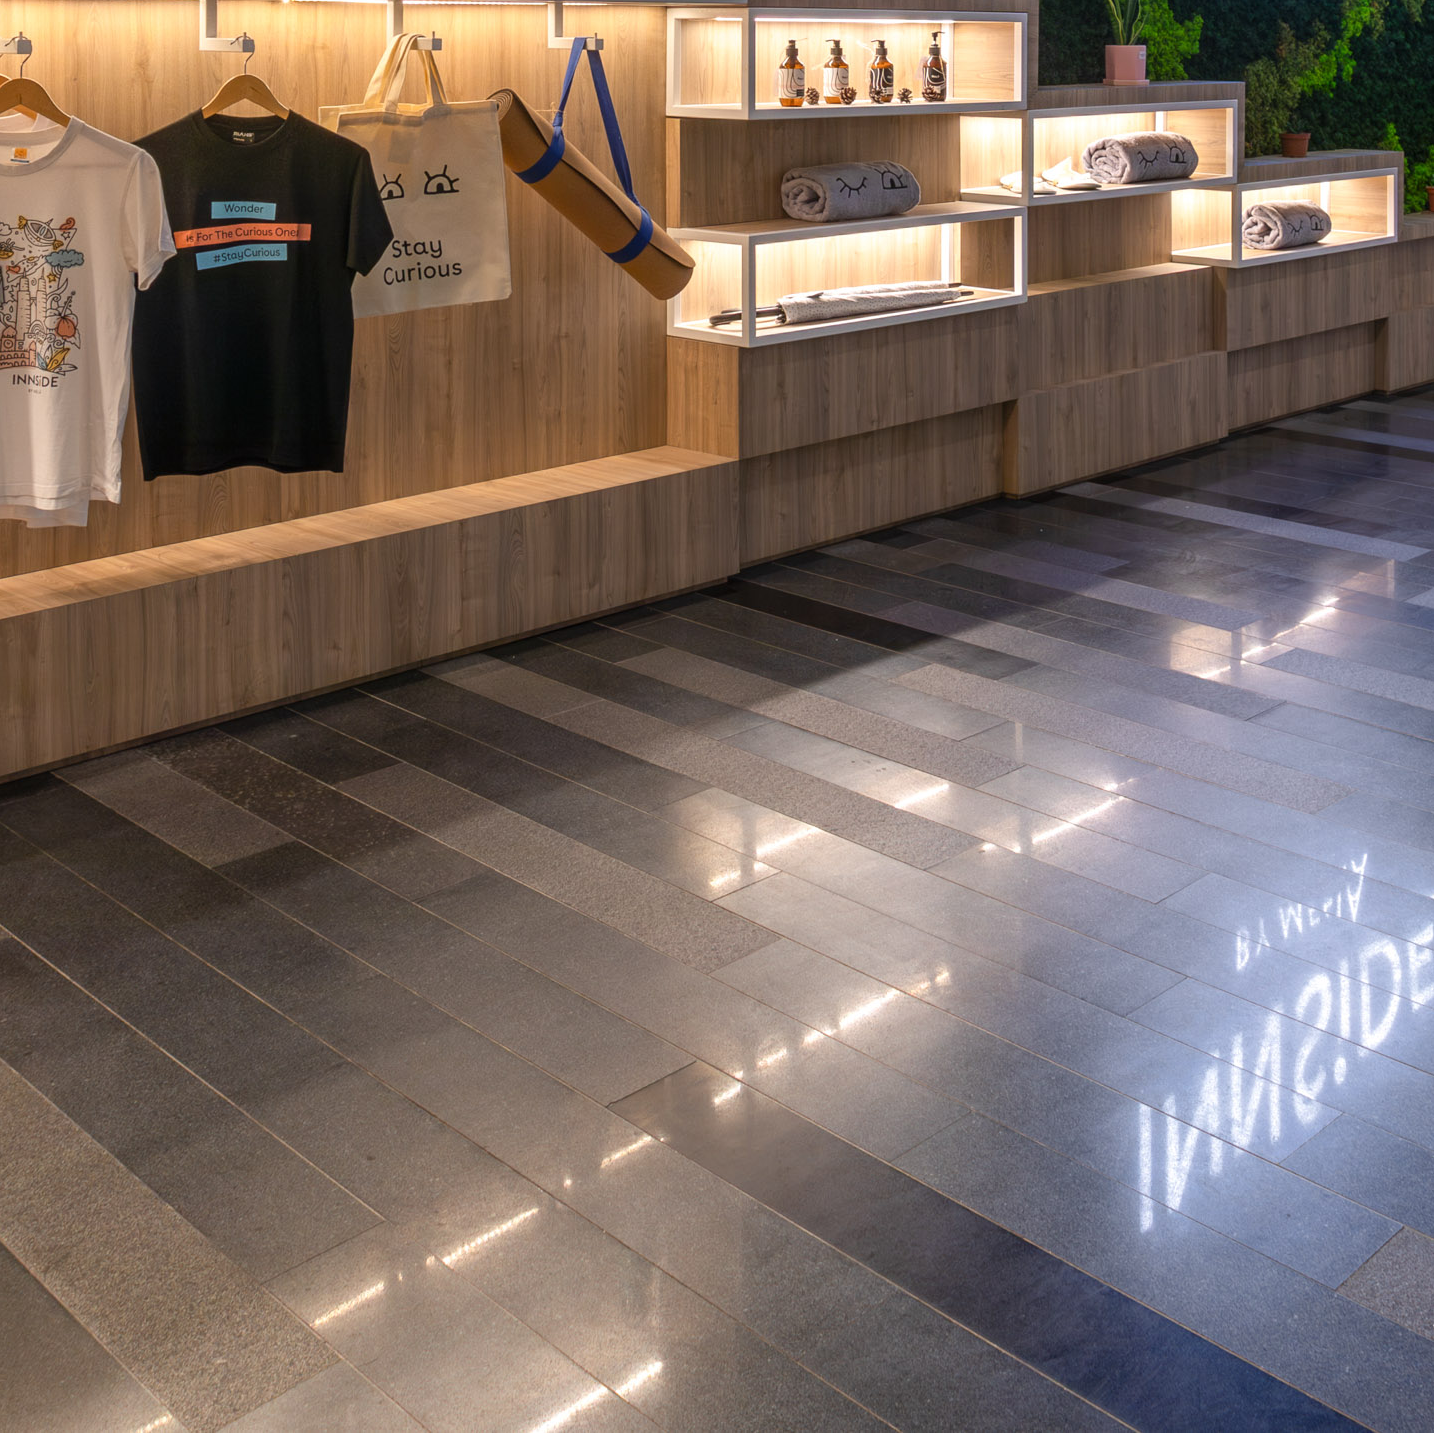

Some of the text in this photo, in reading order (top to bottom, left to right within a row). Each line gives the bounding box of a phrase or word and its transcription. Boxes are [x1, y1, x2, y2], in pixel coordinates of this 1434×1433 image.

[223, 203, 264, 214] Wonder
[196, 231, 213, 242] For
[215, 229, 233, 240] The
[235, 227, 273, 238] Curious
[213, 247, 281, 263] #StayCurious
[391, 239, 443, 259] Stay
[383, 261, 463, 286] Curious
